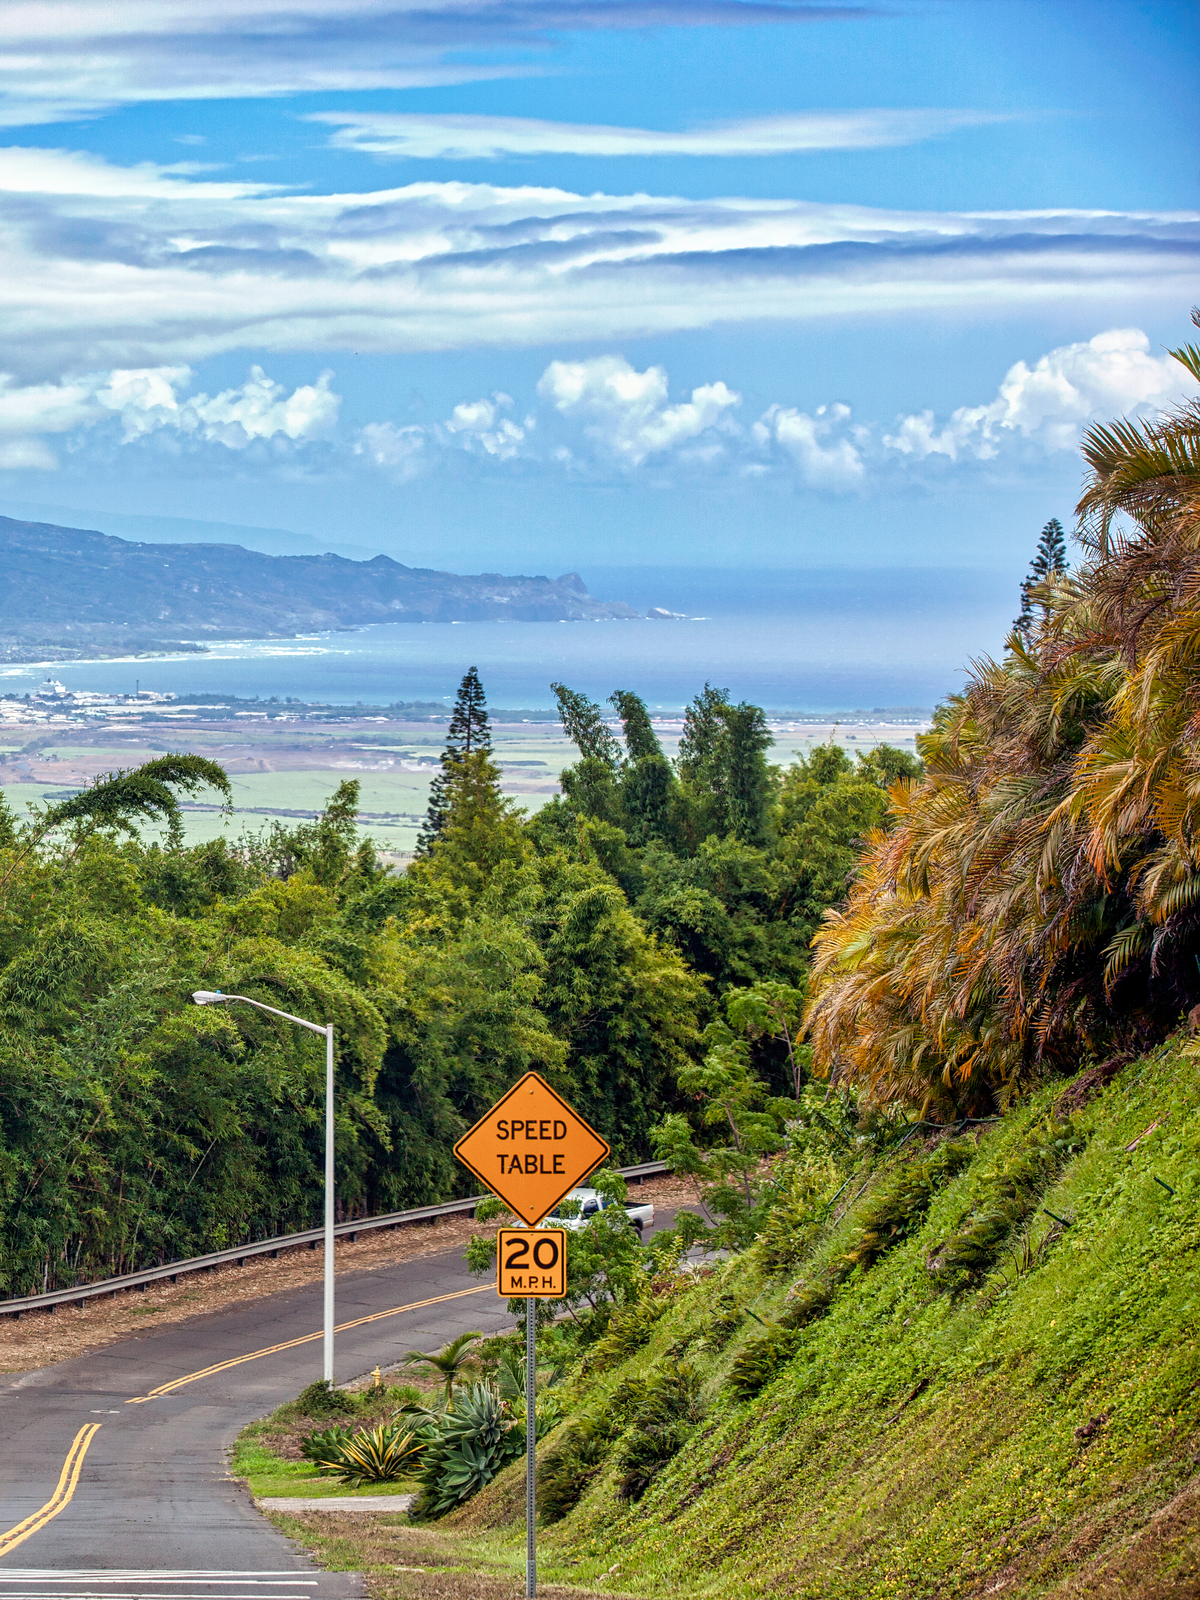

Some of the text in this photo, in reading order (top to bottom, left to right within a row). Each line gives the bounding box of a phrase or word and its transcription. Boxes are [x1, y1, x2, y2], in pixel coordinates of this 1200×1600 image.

[496, 1120, 567, 1140] SPEED
[497, 1154, 566, 1175] TABLE
[505, 1238, 559, 1270] 20
[511, 1276, 556, 1289] M.P.H.
